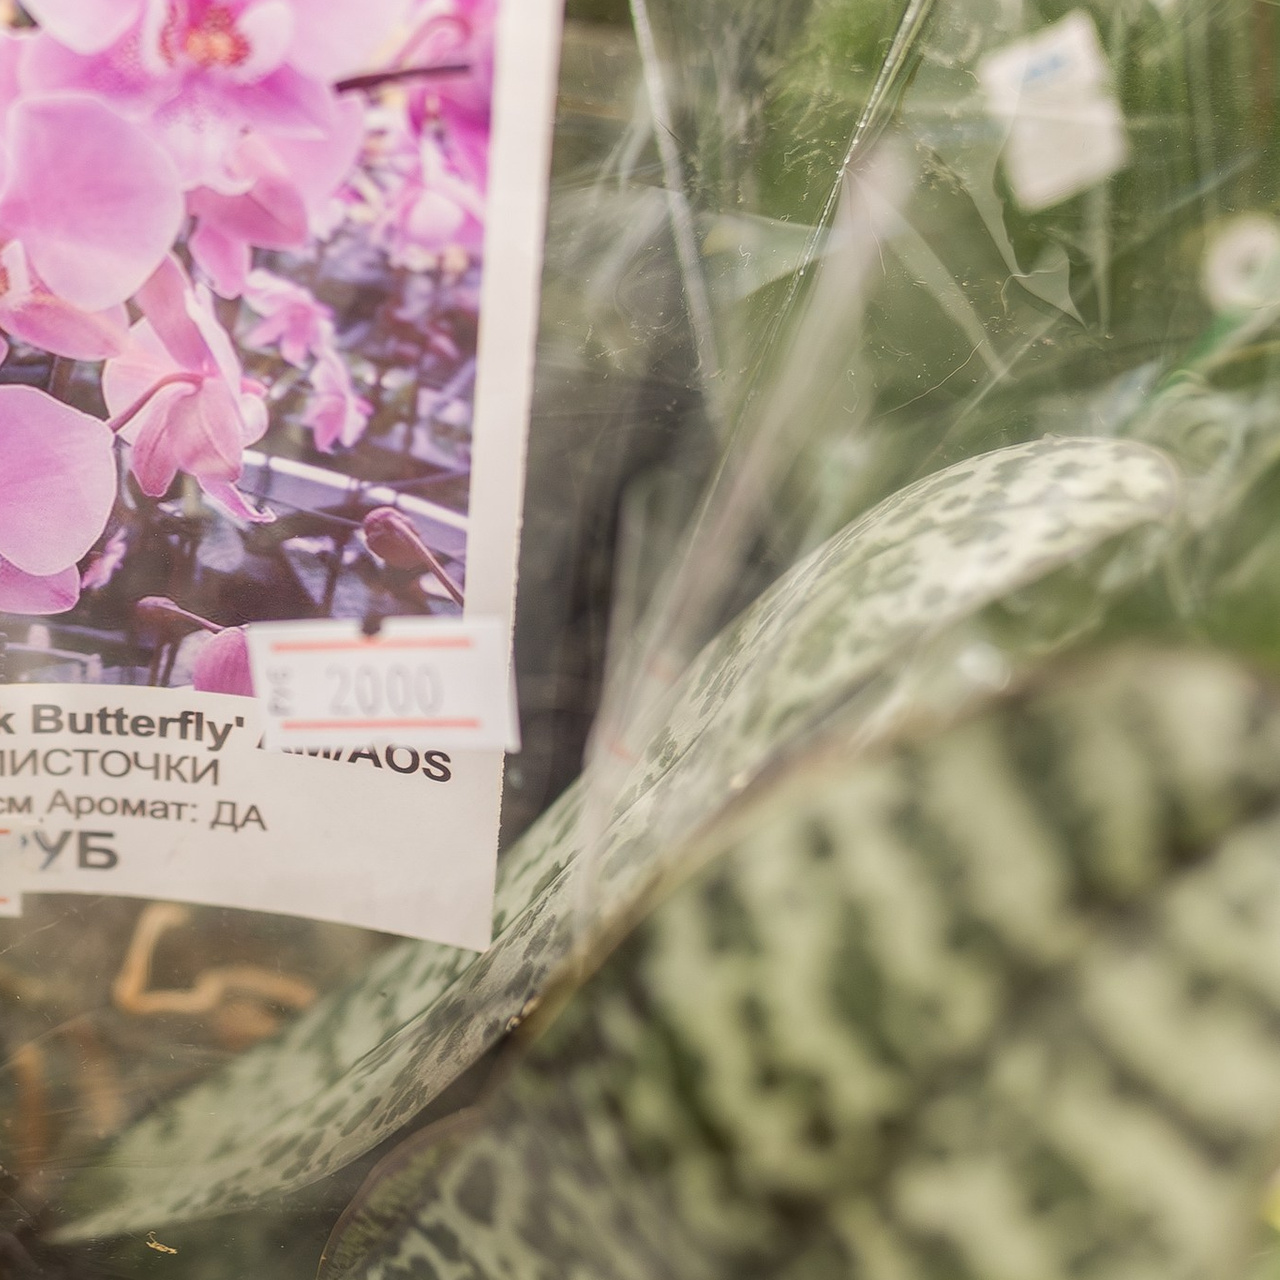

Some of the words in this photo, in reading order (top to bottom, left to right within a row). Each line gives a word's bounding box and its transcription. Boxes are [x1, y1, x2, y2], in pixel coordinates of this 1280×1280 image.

[325, 663, 445, 717] 2000
[31, 704, 245, 752] Butterfly'
[49, 789, 199, 823] Аромат:
[209, 800, 268, 832] ДА
[20, 830, 119, 871] УБ
